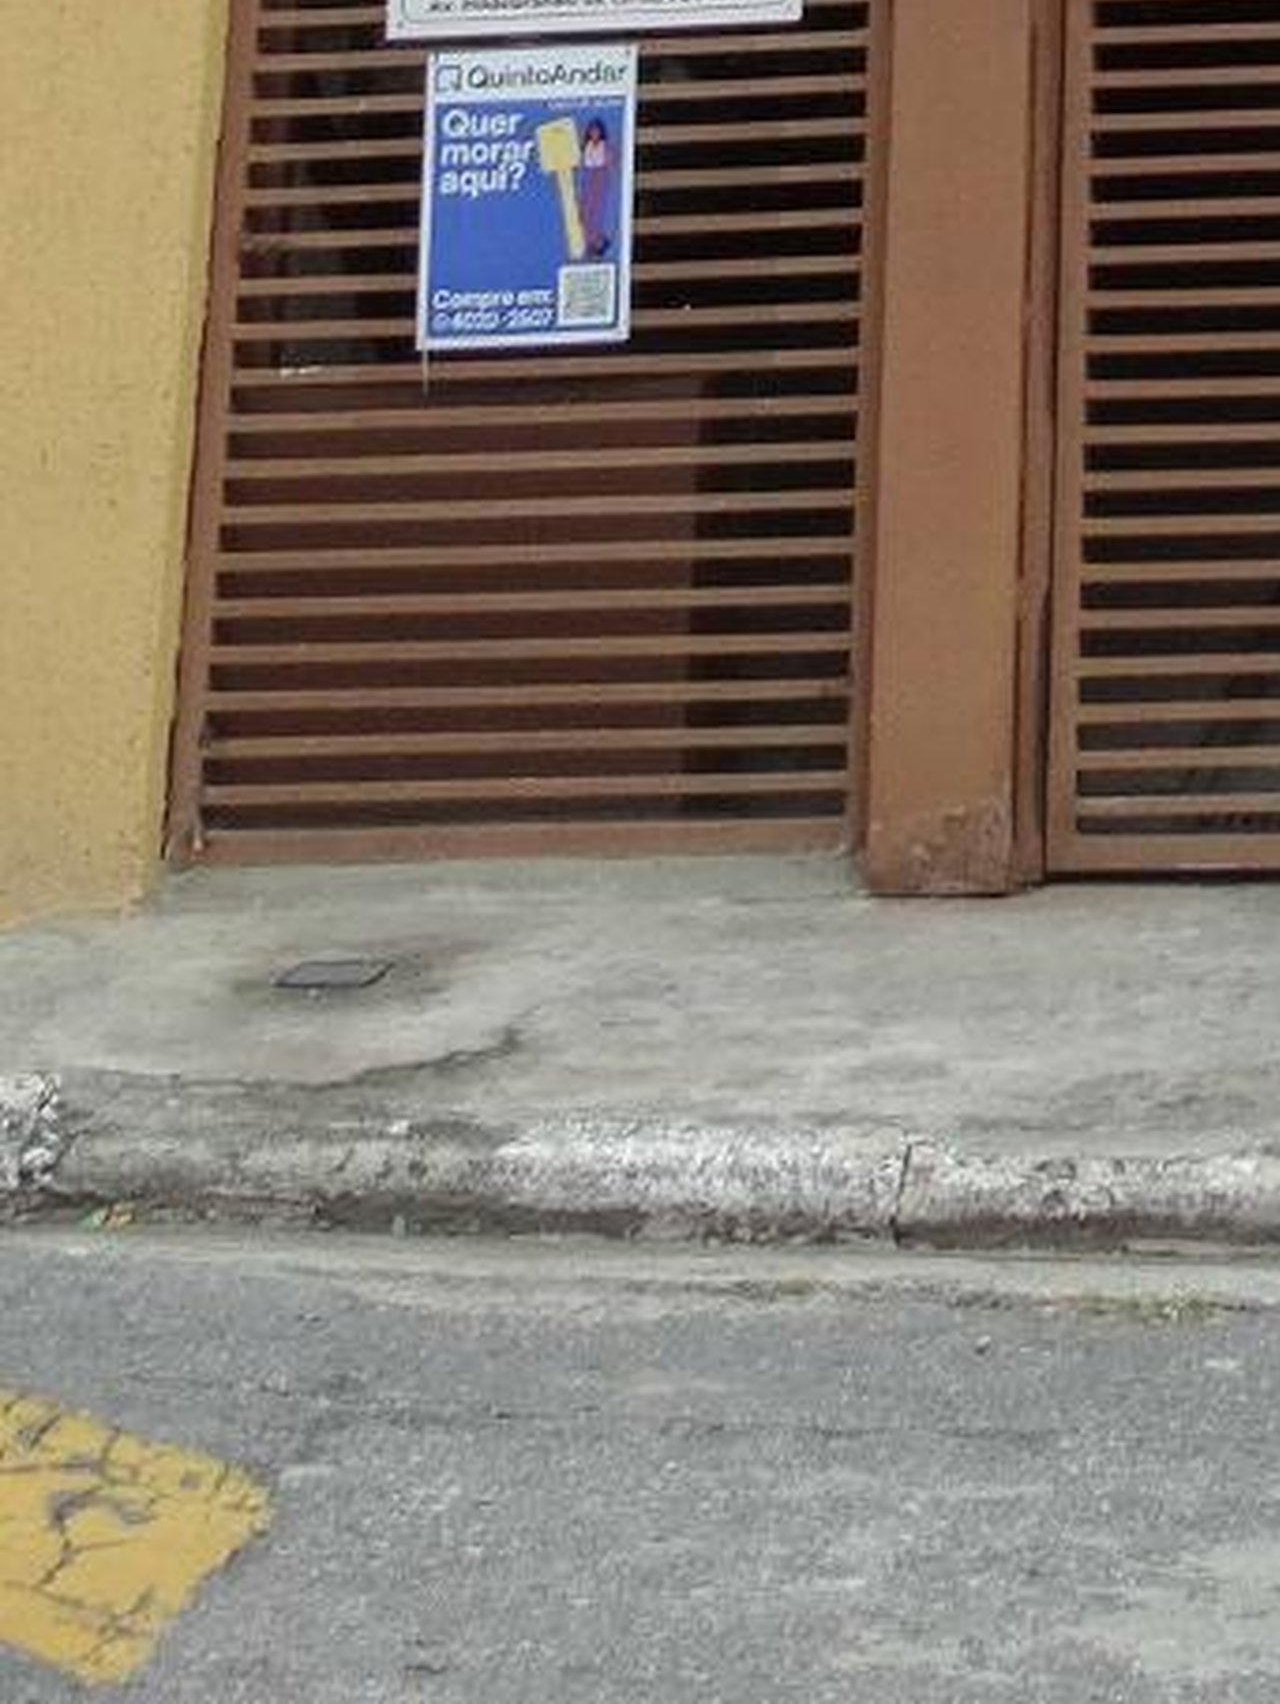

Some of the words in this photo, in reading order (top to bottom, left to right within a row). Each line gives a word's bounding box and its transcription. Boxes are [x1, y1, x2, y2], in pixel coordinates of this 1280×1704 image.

[468, 61, 629, 89] QuintoAndar
[441, 108, 524, 140] Quer
[440, 138, 537, 165] morar
[440, 161, 528, 198] aqui?
